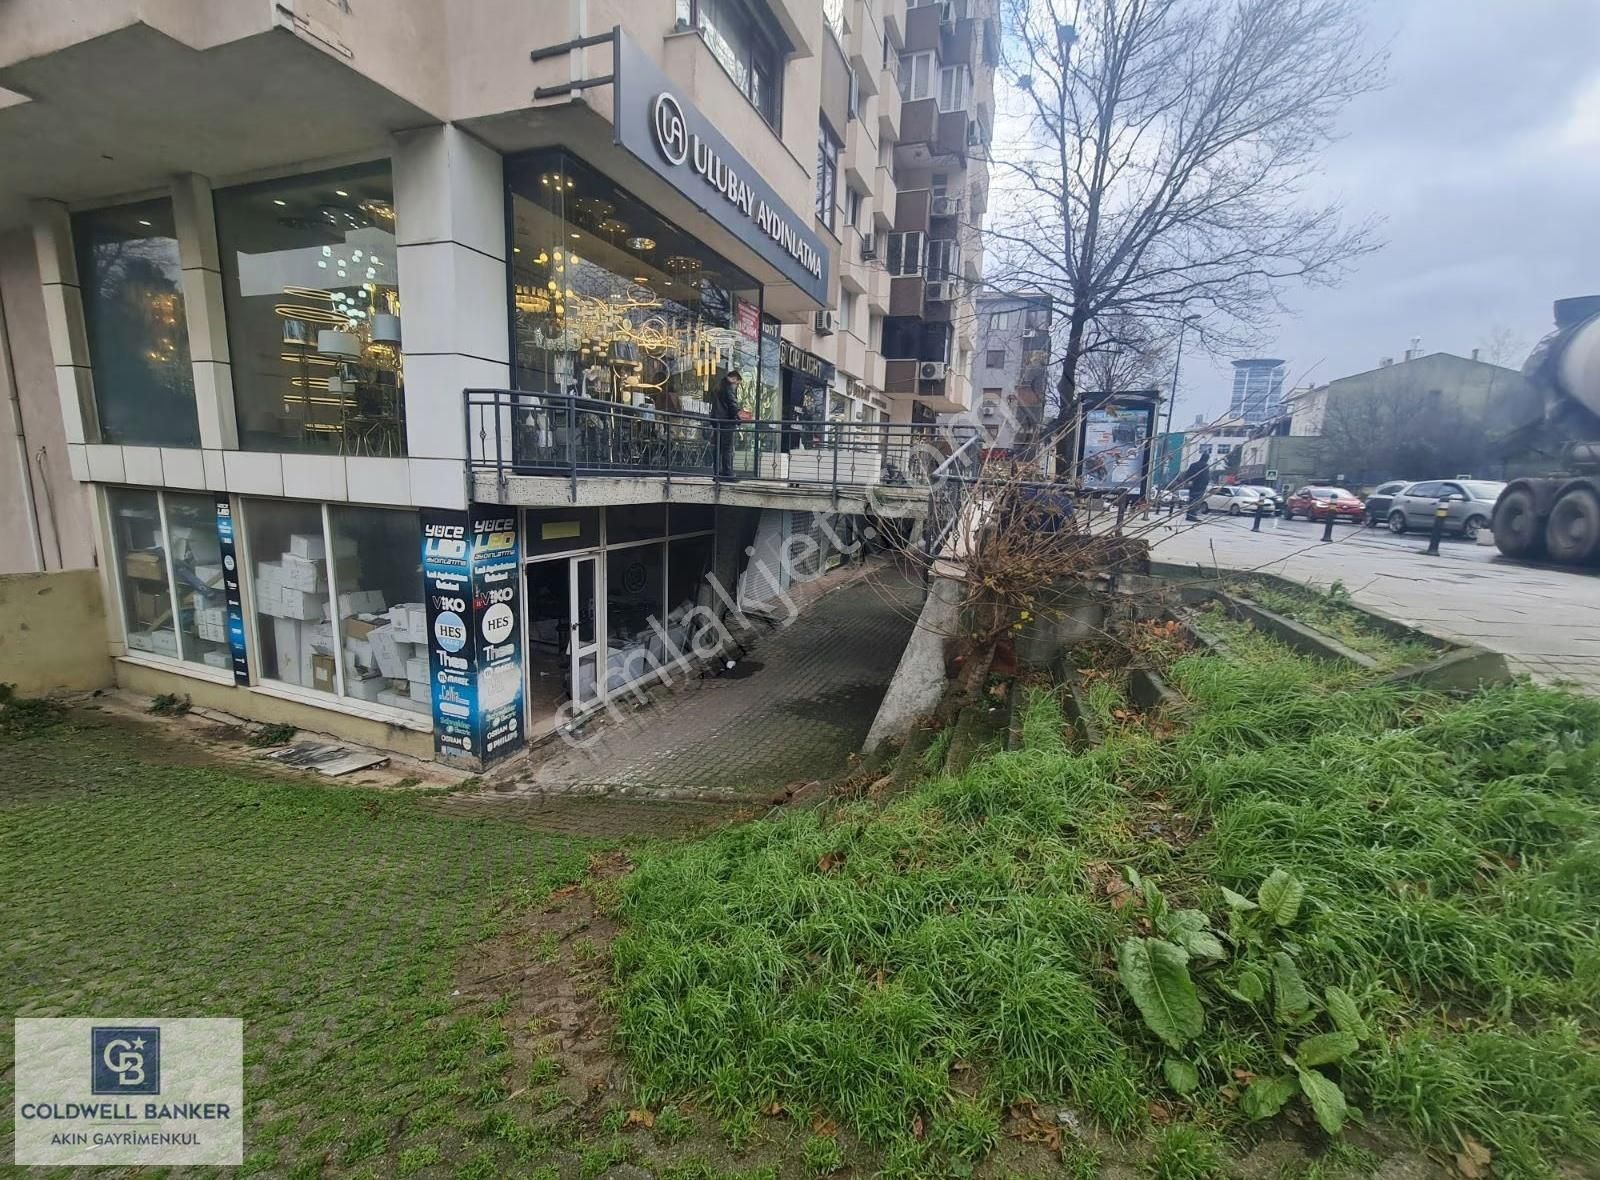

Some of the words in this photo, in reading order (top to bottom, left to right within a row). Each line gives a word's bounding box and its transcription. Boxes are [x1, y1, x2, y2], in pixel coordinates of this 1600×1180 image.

[694, 134, 755, 217] ULUBAY
[757, 200, 822, 280] AYDINLATMA
[488, 616, 509, 631] HES
[440, 625, 462, 639] HES
